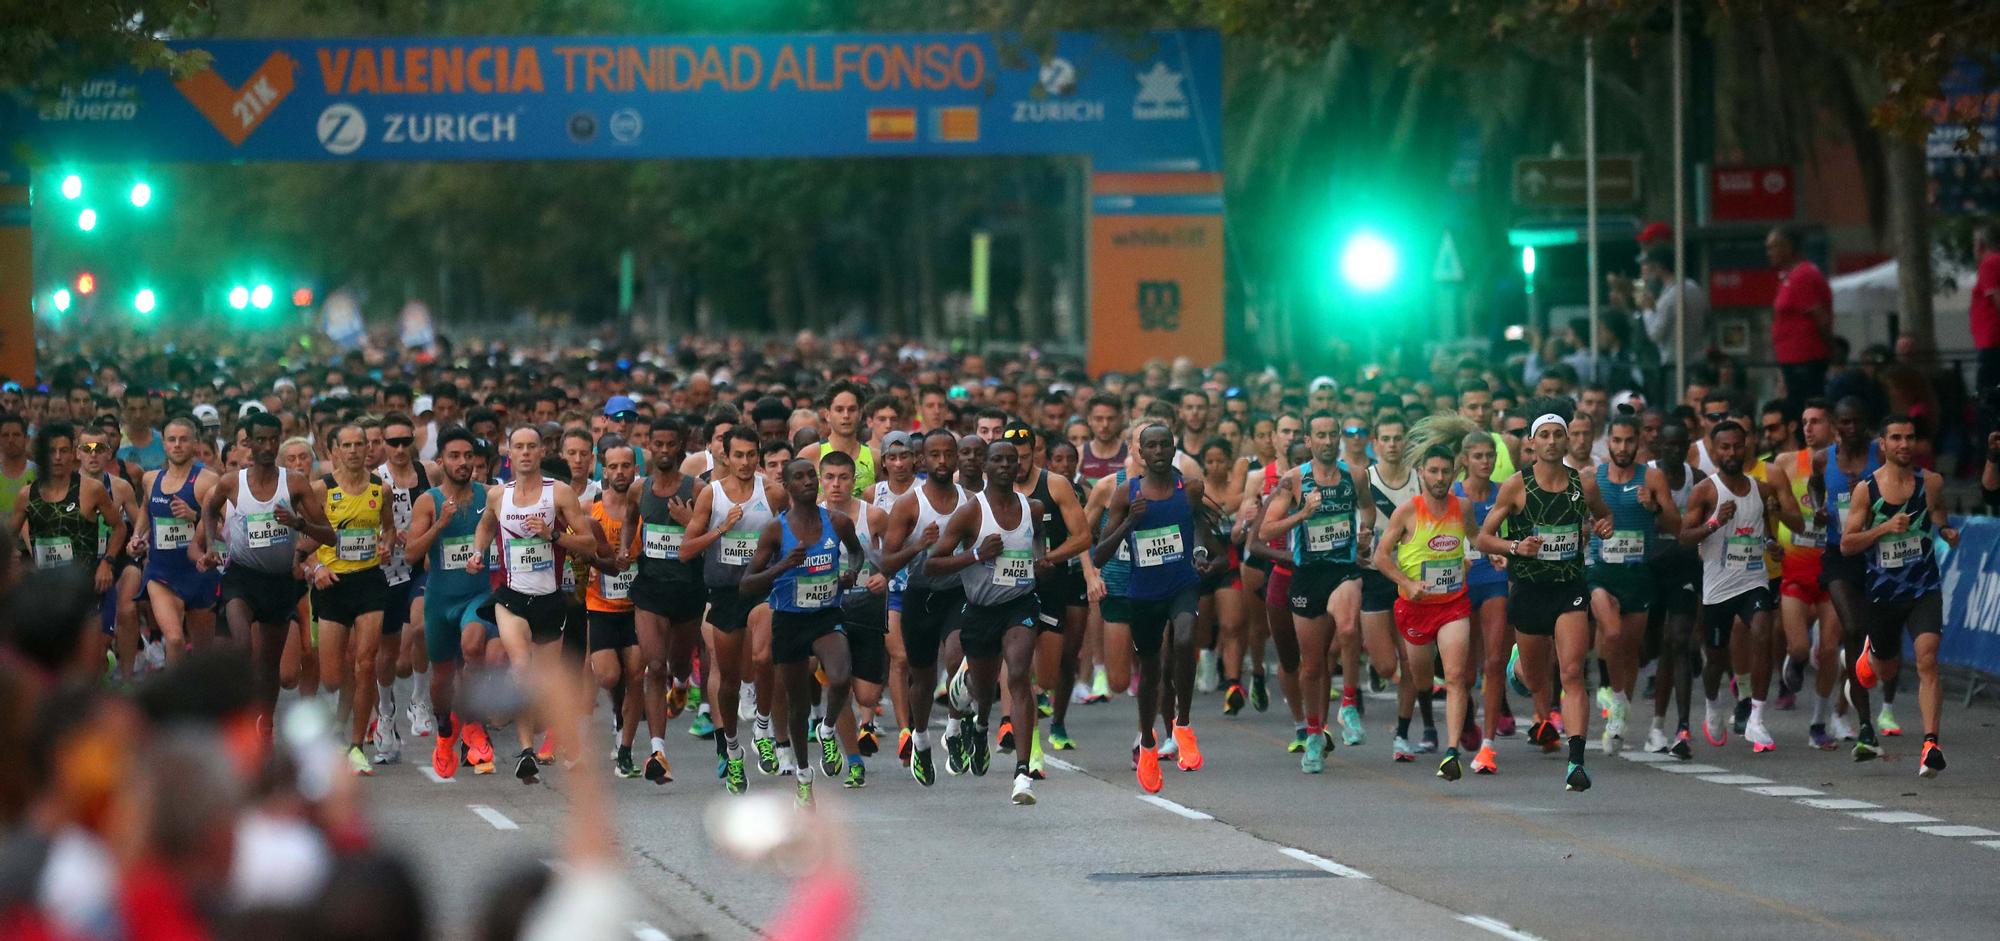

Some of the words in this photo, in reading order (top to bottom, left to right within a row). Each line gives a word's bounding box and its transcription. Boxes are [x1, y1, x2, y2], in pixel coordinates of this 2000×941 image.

[317, 47, 544, 94] VALENCIA
[553, 44, 762, 93] TRINIDAD
[768, 42, 986, 91] ALFONSO
[232, 75, 279, 129] 21K
[382, 113, 518, 143] ZURICH
[506, 511, 547, 521] BORDUX
[265, 521, 272, 529] 6
[164, 534, 187, 542] Adam
[248, 528, 289, 540] KEJELCHA
[356, 537, 366, 545] 77
[1151, 537, 1166, 547] 111
[1555, 535, 1566, 543] 37
[736, 540, 747, 548] 22
[1543, 542, 1576, 552] BLANCO
[525, 547, 536, 555] 58
[724, 547, 757, 557] CAIRES
[1146, 544, 1175, 557] PACER
[520, 555, 542, 564] Fifou
[1882, 552, 1890, 560] El
[1011, 560, 1025, 568] 113
[813, 584, 828, 592] 110
